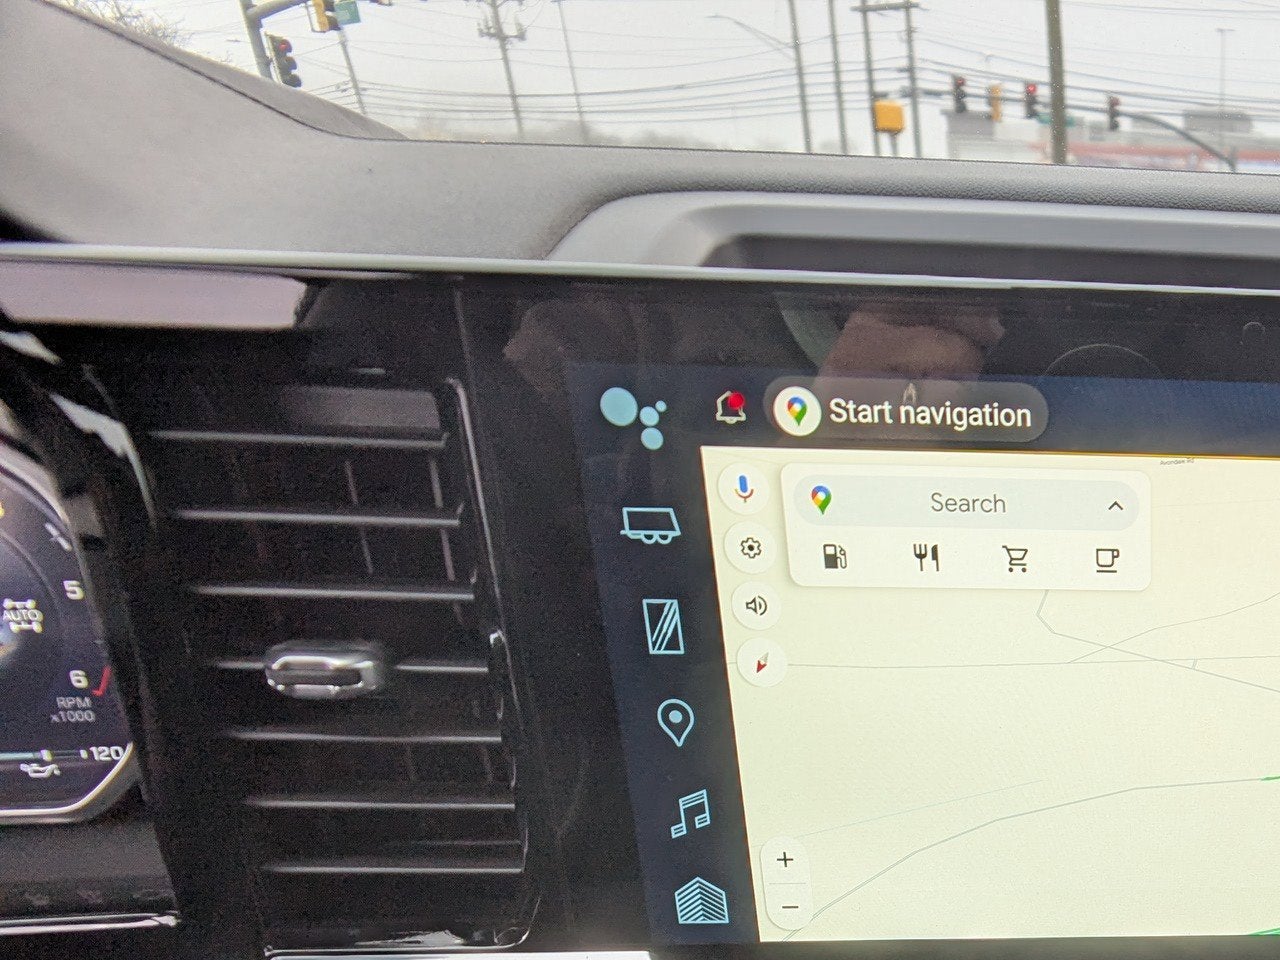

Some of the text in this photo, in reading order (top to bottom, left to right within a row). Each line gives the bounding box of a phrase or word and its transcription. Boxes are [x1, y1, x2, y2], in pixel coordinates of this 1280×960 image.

[829, 397, 1032, 431] Start navigation
[930, 492, 1007, 514] Search
[63, 580, 85, 600] 5
[3, 609, 43, 622] AUTO
[69, 670, 89, 689] 6
[56, 697, 92, 710] RPM
[51, 710, 96, 723] x1000
[89, 746, 123, 761] 120
